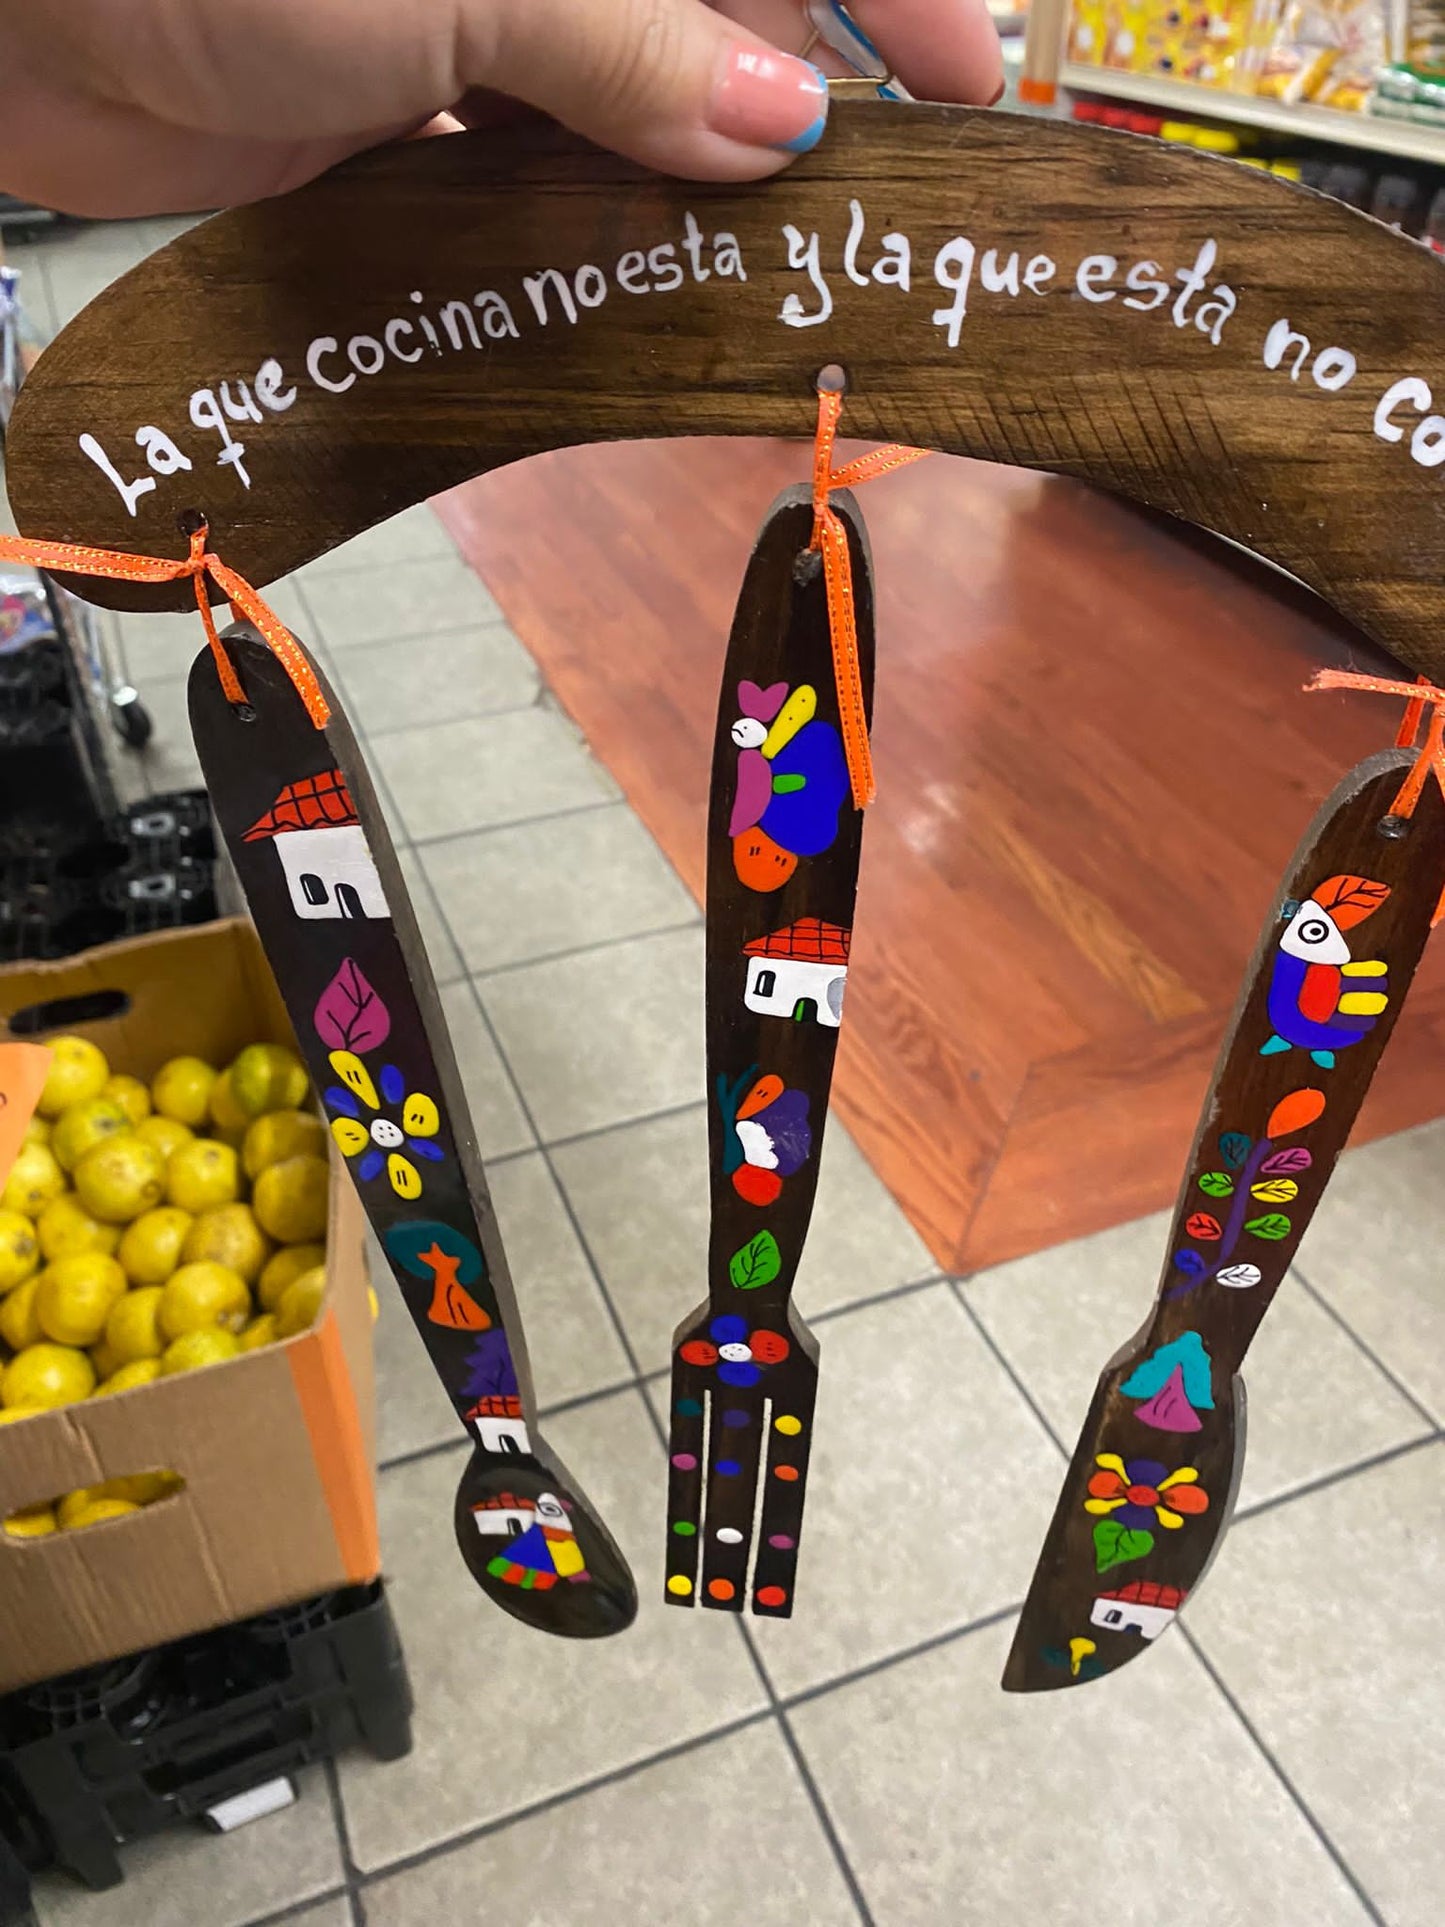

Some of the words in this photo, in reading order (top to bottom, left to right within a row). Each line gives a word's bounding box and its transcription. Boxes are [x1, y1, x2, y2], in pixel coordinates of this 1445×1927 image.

[79, 426, 192, 516] La
[190, 357, 296, 489] que
[524, 265, 606, 325] no
[617, 211, 747, 294] esta
[778, 224, 833, 327] y
[844, 199, 909, 292] la
[932, 236, 1055, 347] que
[1075, 238, 1237, 345] esta
[1263, 318, 1356, 392] no
